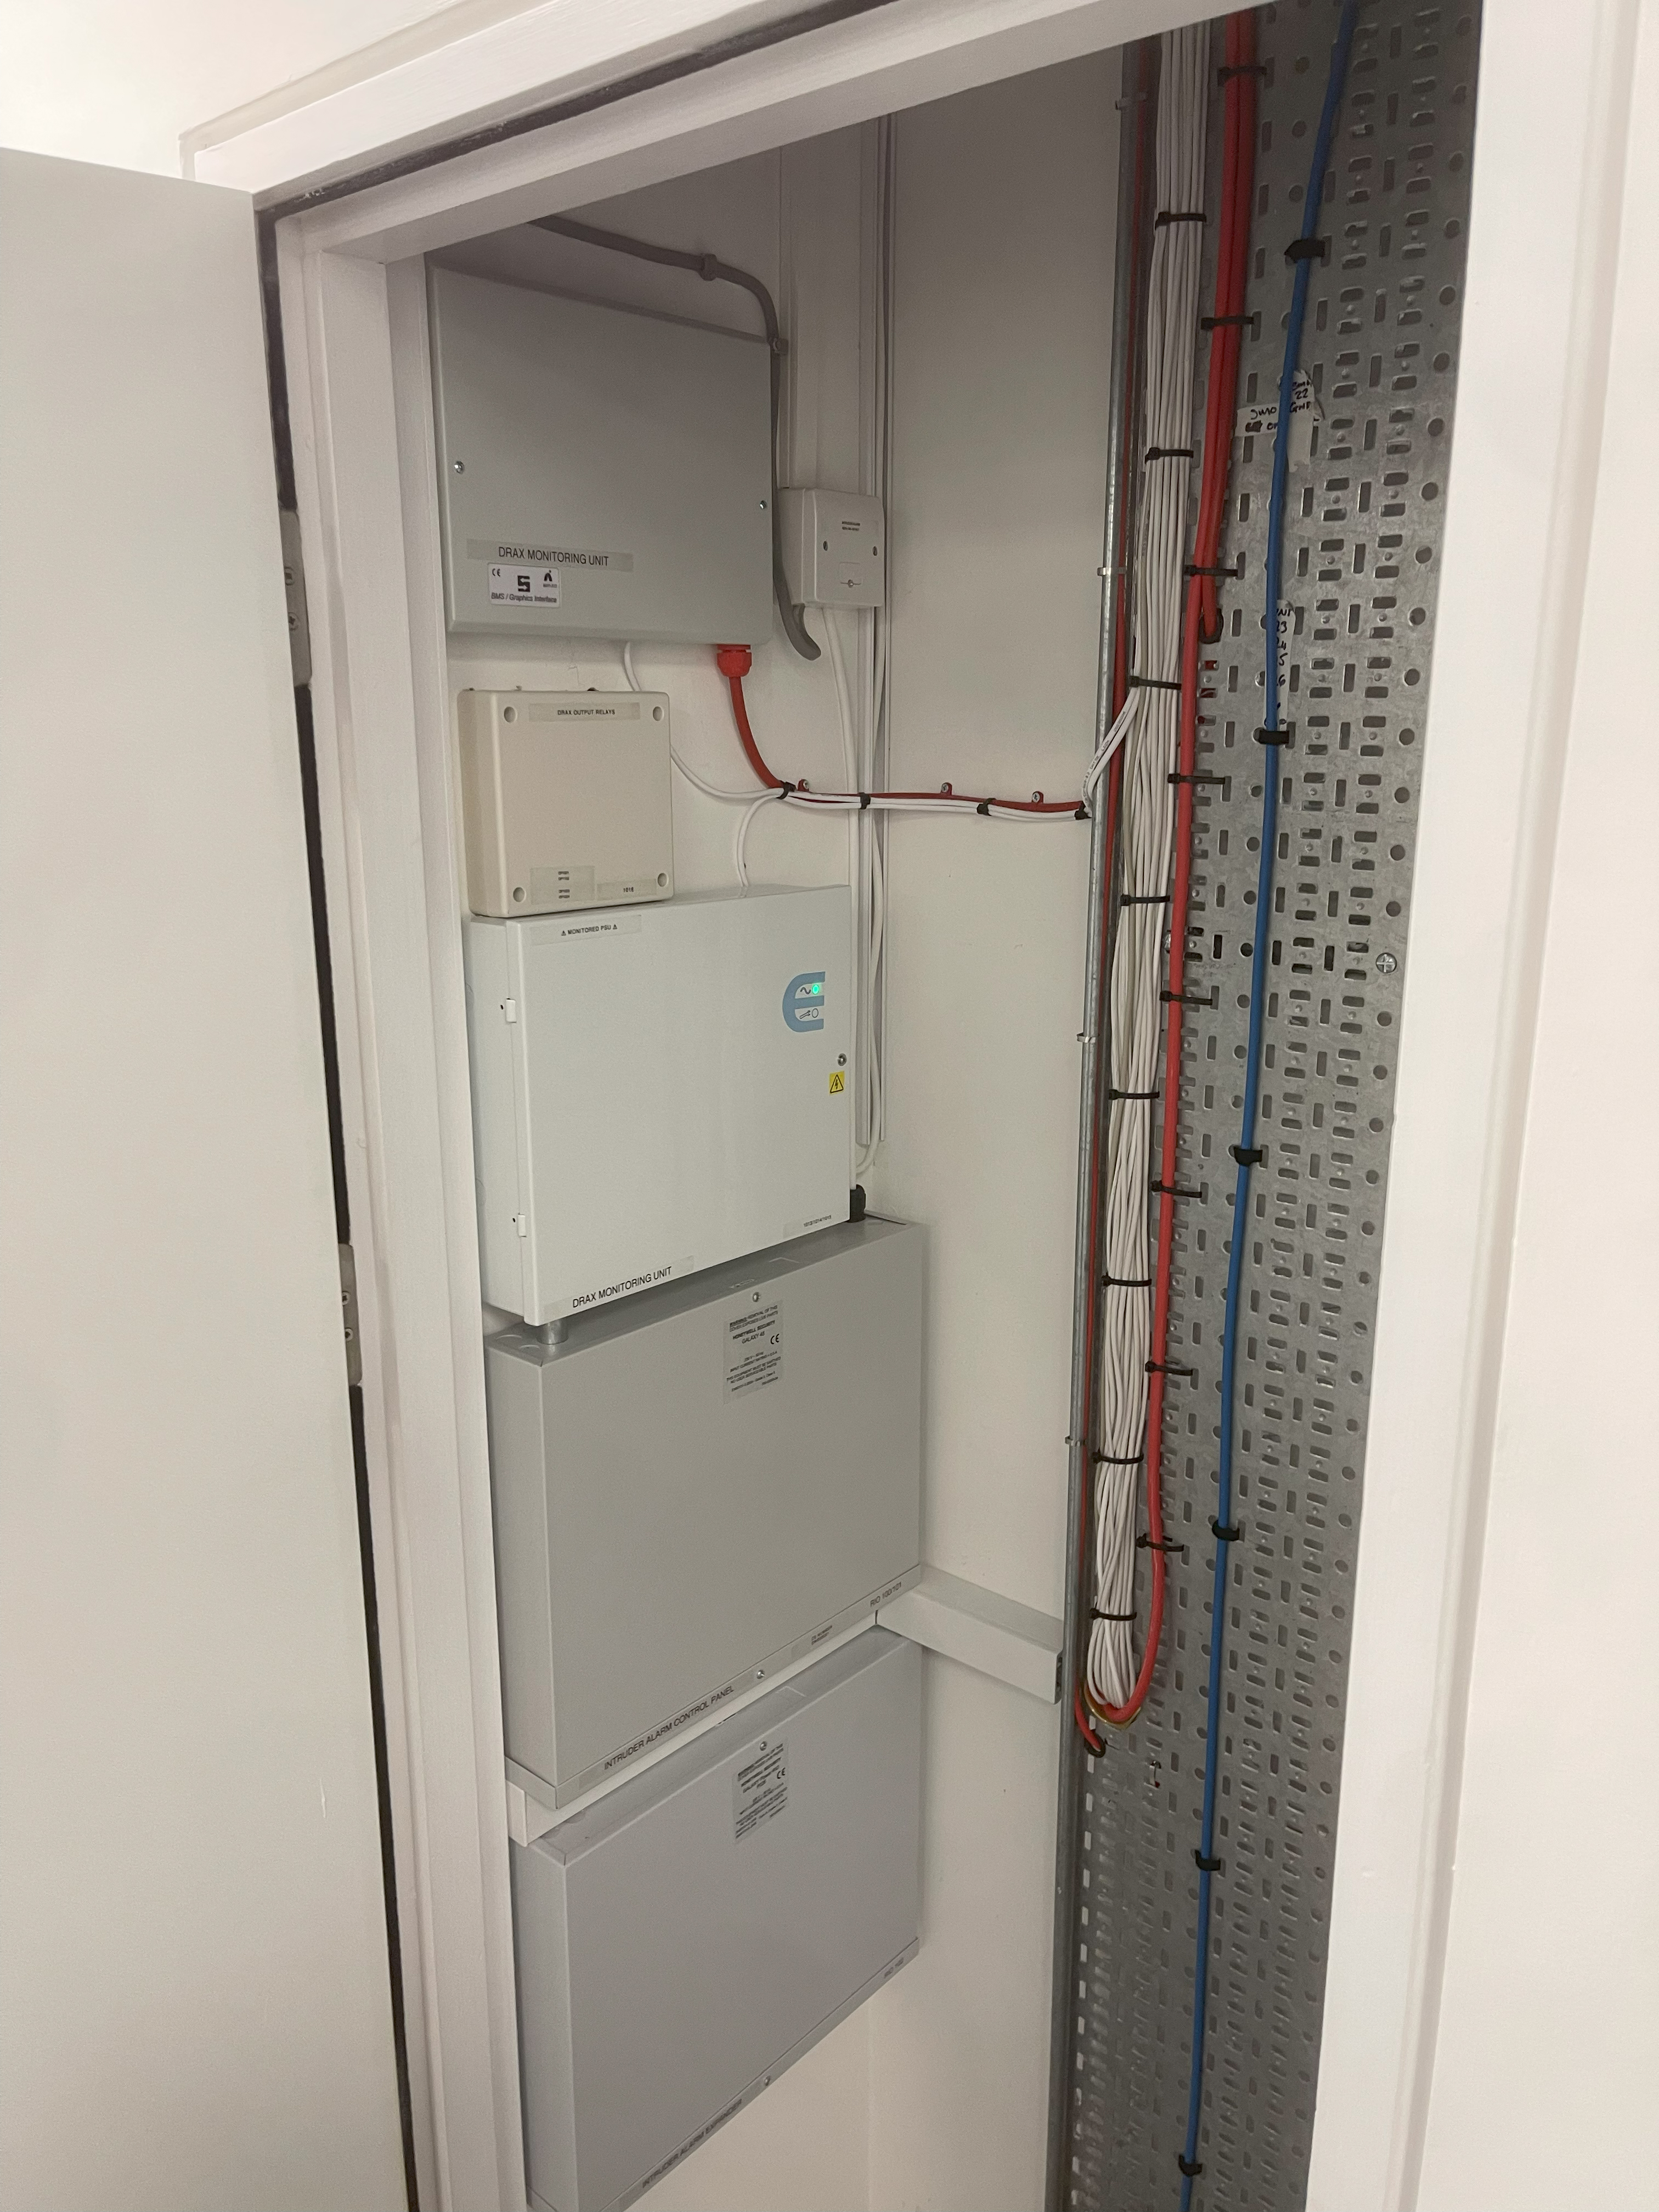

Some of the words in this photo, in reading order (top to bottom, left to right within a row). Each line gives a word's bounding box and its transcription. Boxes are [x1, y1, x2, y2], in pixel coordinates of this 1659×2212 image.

[498, 546, 525, 559] DRAX
[527, 549, 586, 564] MONITORING
[589, 555, 609, 566] UNIT
[509, 594, 533, 602] Graphics
[567, 926, 599, 935] MONITORED
[572, 1292, 596, 1308] DRAX
[599, 1273, 652, 1299] MONITORING
[653, 1266, 672, 1280] UNIT
[742, 1332, 760, 1344] GALAXY
[603, 1740, 645, 1770] INTRUDER
[645, 1722, 673, 1745] ALARM
[673, 1701, 710, 1726] CONTROL
[710, 1685, 734, 1704] PANEL
